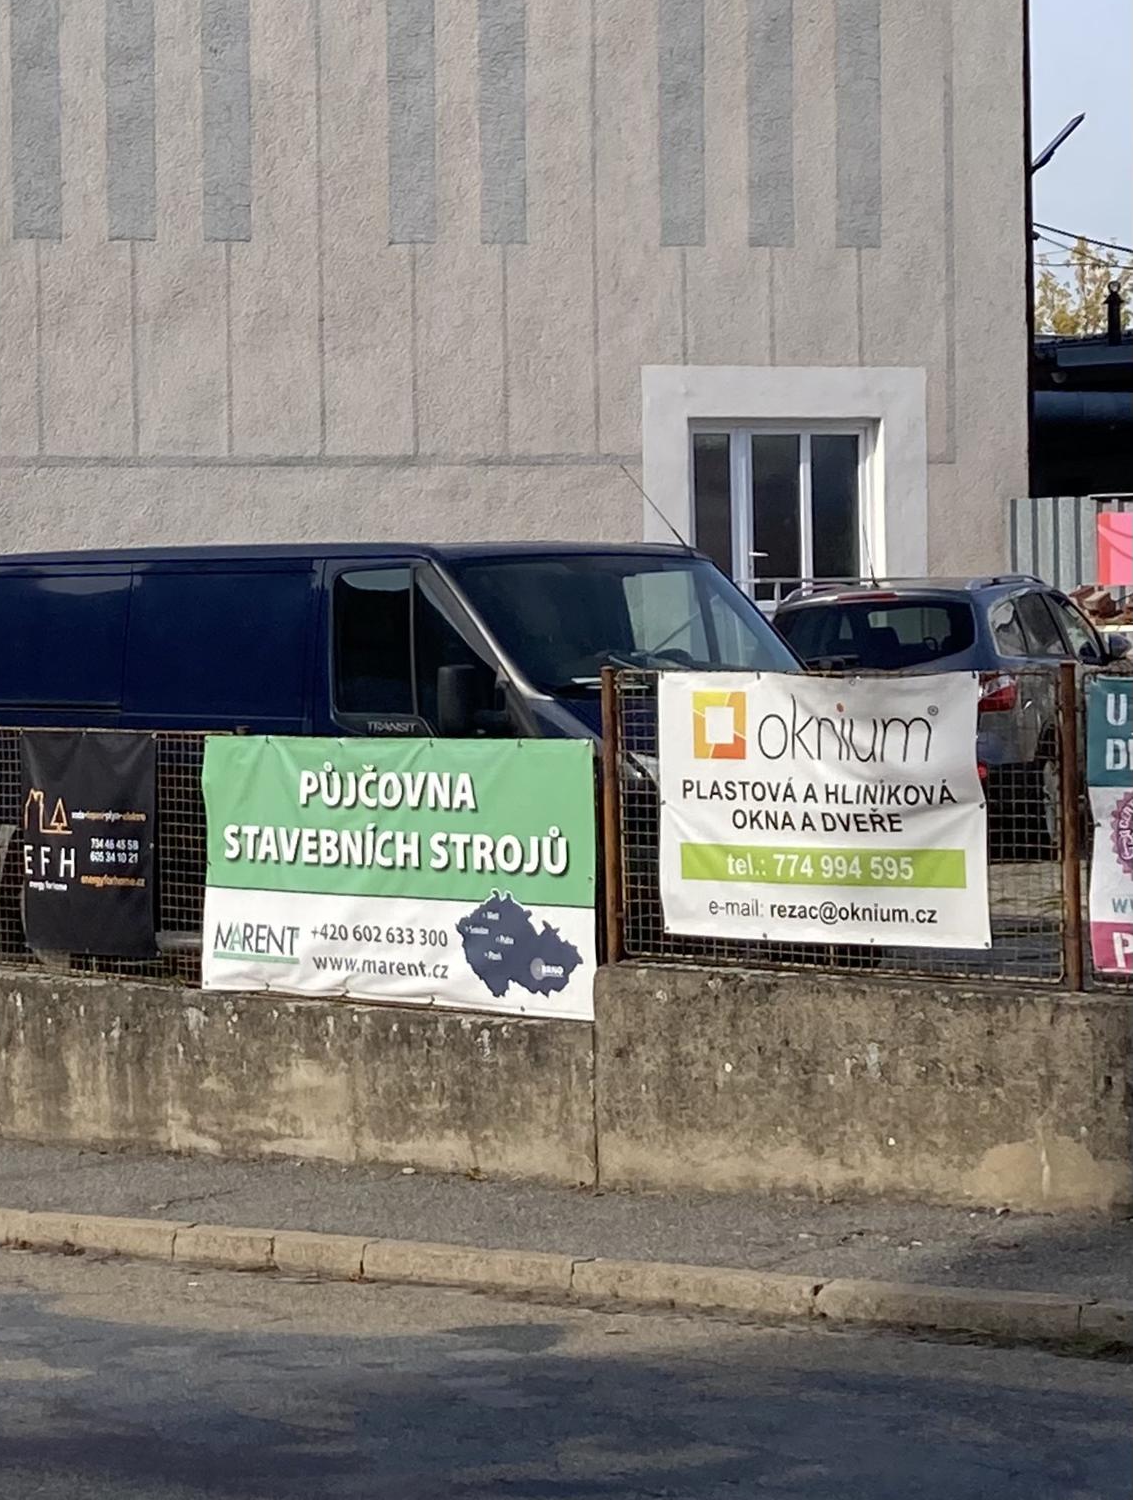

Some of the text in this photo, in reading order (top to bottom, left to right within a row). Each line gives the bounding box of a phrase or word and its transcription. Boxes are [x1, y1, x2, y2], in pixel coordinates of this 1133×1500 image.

[367, 721, 416, 733] TRANSIT
[758, 693, 933, 763] oknium
[299, 761, 477, 811] PŮJČOVNA
[682, 777, 957, 806] PLASTOVÁ A HLINÍKOVÁ
[732, 809, 903, 833] OKNA A DVEŘE
[223, 823, 568, 875] STAVEBNÍCH STROJŮ
[727, 853, 914, 881] tel.: 774 994 595
[708, 899, 938, 925] e-mail: rezac@oknium.cz
[214, 921, 300, 956] MARENT
[310, 924, 448, 947] +420 602 633 300
[313, 956, 449, 979] www.marent.cz
